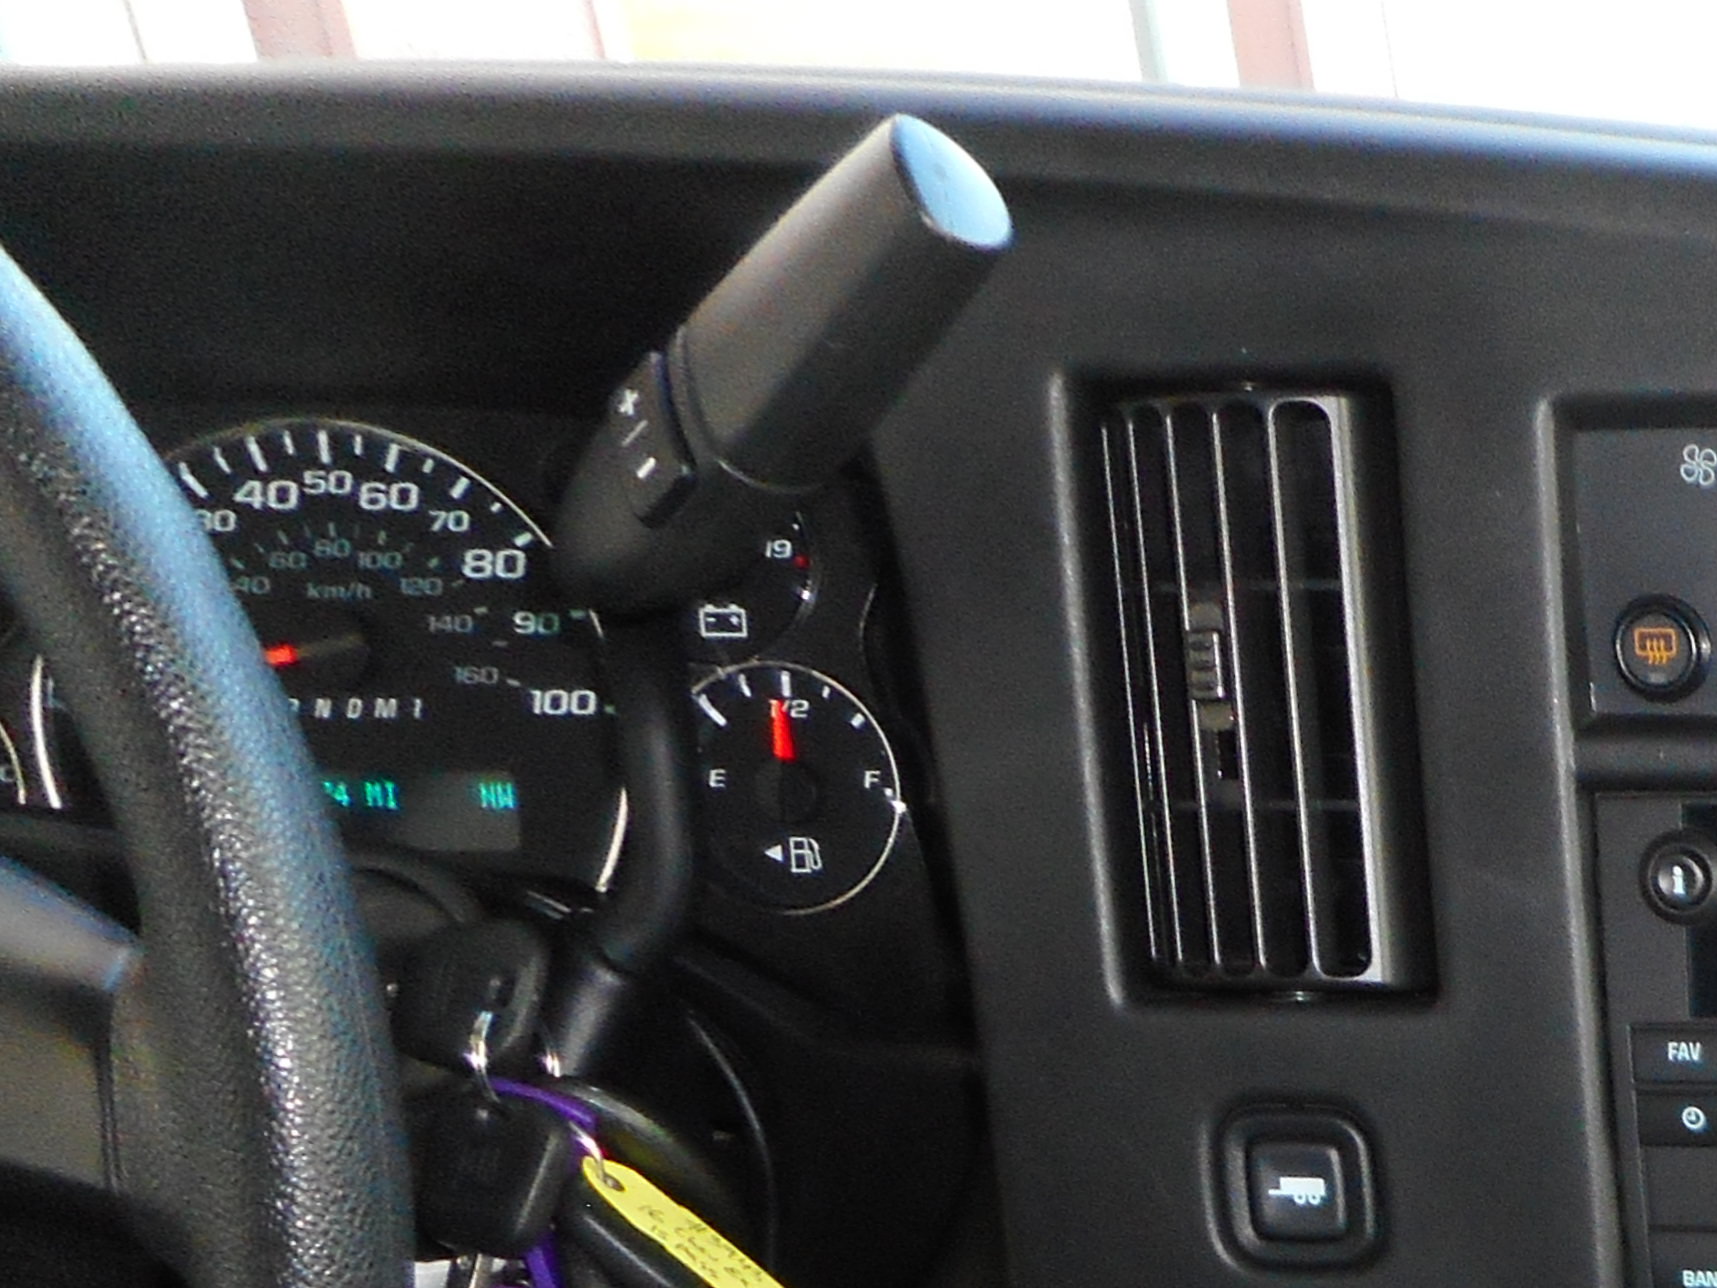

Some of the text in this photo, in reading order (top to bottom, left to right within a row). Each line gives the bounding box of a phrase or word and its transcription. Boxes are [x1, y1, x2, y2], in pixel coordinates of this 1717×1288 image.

[303, 470, 353, 495] 50
[233, 480, 299, 510] 40
[358, 482, 419, 511] 60
[429, 510, 470, 532] 70
[765, 539, 792, 559] 19
[462, 548, 526, 579] 80
[306, 581, 372, 600] km/h
[426, 614, 474, 634] 140
[511, 609, 561, 636] 90
[454, 665, 500, 686] 160
[530, 689, 597, 715] 100
[708, 769, 726, 788] E
[864, 770, 881, 789] F
[1667, 1041, 1701, 1062] FAV
